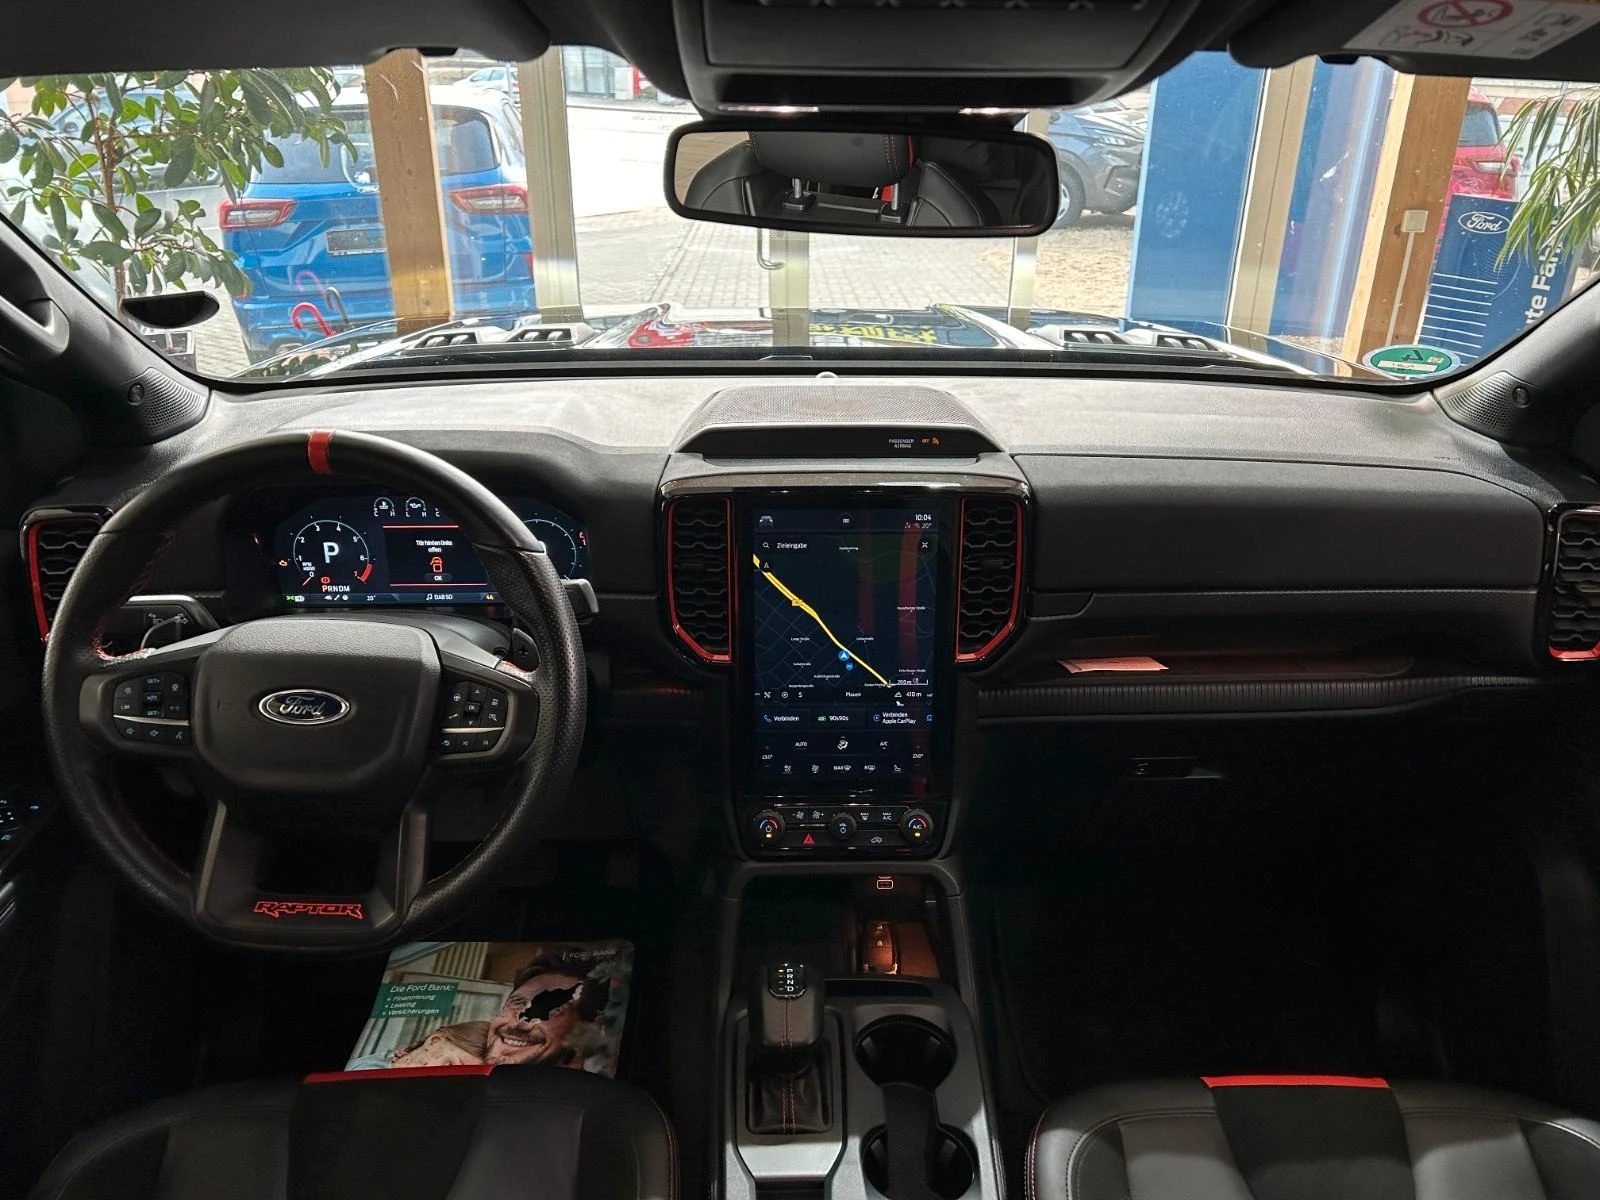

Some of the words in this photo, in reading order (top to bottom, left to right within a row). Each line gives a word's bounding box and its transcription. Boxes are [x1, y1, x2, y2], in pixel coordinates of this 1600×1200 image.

[1466, 213, 1502, 232] Ford
[776, 542, 808, 550] Zieleingabe
[322, 541, 340, 564] P
[279, 695, 326, 715] Ford
[253, 901, 363, 920] RAPTOR
[390, 985, 406, 993] Die
[406, 983, 428, 992] Ford
[428, 983, 455, 992] Bank:
[392, 994, 436, 1002] Finanzierung
[389, 1001, 417, 1009] Leasing
[388, 1008, 439, 1016] Versicherungen
